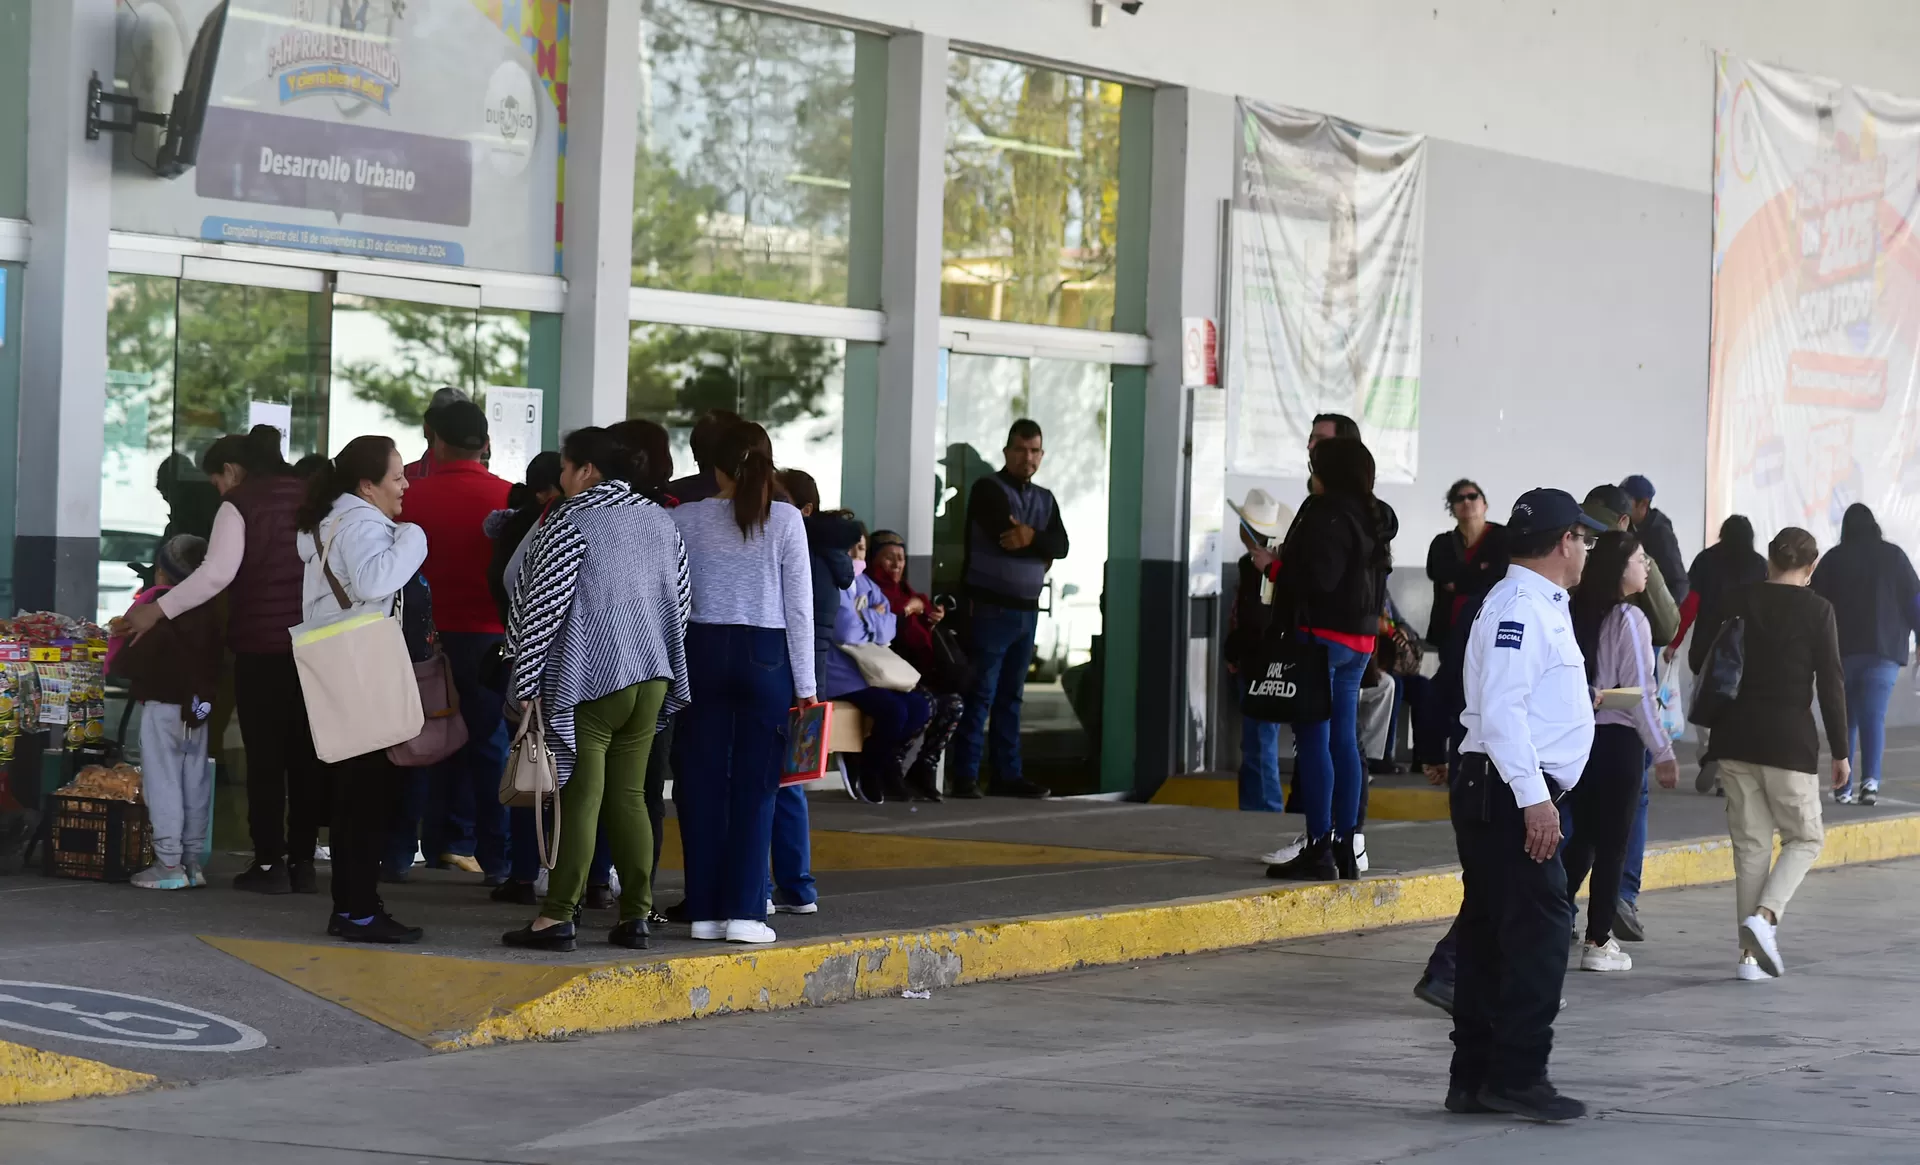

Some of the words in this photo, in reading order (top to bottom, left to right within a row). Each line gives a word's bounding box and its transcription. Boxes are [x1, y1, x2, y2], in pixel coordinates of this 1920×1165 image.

[259, 146, 351, 184] Desarrollo
[355, 158, 416, 191] Urbano
[222, 223, 257, 239] Campaña
[258, 228, 287, 242] vigente
[287, 230, 299, 243] del
[309, 232, 319, 245] de
[320, 235, 357, 249] noviembre
[357, 238, 365, 249] al
[375, 239, 383, 252] de
[384, 240, 418, 255] diciembre
[419, 244, 428, 256] de
[428, 244, 447, 258] 2024
[1497, 633, 1522, 642] SOCIAL
